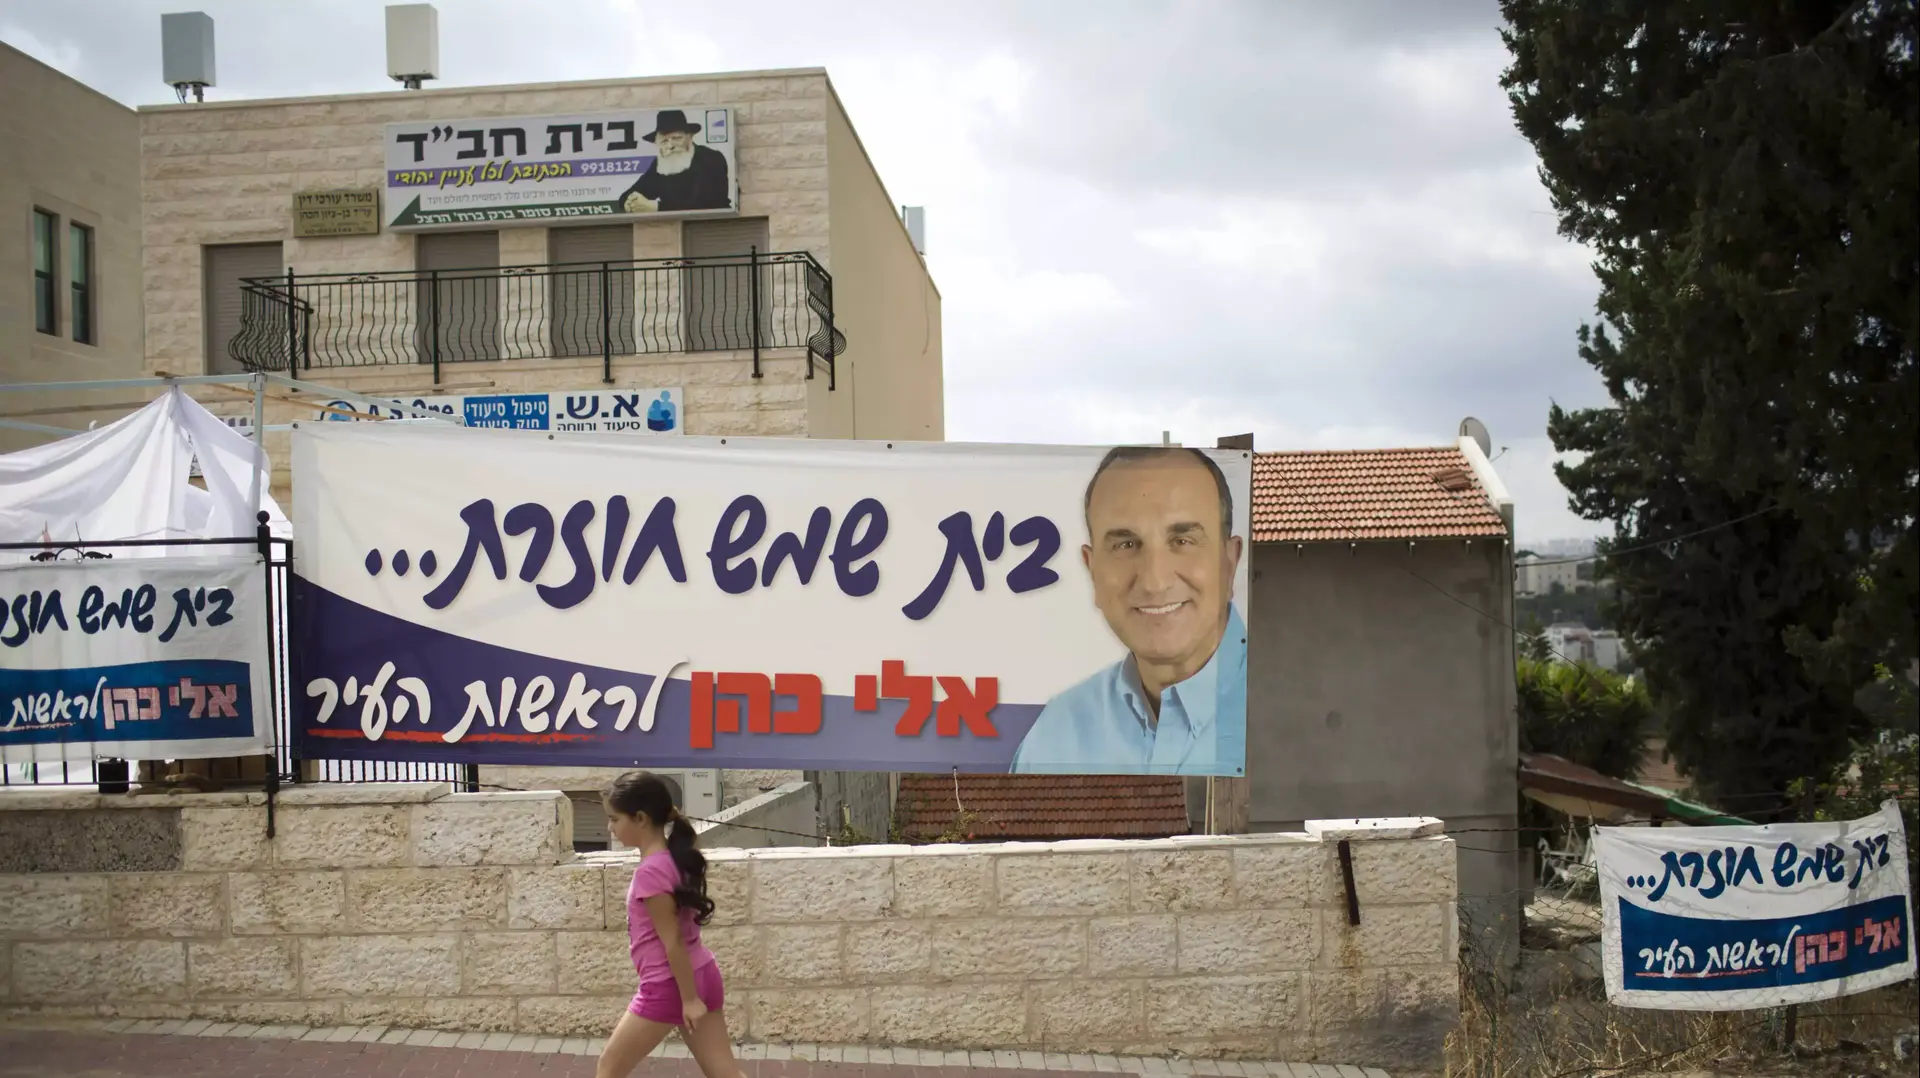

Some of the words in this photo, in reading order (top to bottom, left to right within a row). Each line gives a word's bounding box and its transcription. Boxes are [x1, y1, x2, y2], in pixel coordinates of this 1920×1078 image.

[544, 120, 638, 154] בית
[394, 170, 435, 185] יהודי
[439, 164, 476, 191] עניין
[480, 158, 511, 180] לכל
[507, 161, 573, 184] הכתובת
[580, 160, 640, 174] 9918127
[298, 195, 313, 208] דין
[315, 193, 342, 204] עורכי
[344, 192, 372, 203] משרד
[487, 210, 516, 221] ברק
[517, 207, 552, 218] סומר
[554, 204, 613, 216] באדיבות
[414, 212, 452, 224] הרצל
[465, 401, 506, 418] סיעודי
[511, 398, 547, 416] טיפול
[557, 421, 597, 432] ורווחה
[603, 420, 641, 432] סיעוד
[706, 494, 889, 598] שמש
[902, 510, 1061, 620] בית
[76, 583, 157, 635] שמש
[158, 586, 235, 643] בית
[7, 675, 108, 732] לראשות
[102, 686, 161, 731] כהן
[168, 676, 240, 719] אלי
[306, 660, 432, 742] העיר
[441, 661, 689, 744] לראשות
[689, 671, 823, 749] כהן
[853, 659, 999, 737] אלי
[1772, 842, 1844, 887] שמש
[1848, 833, 1891, 890] בית
[1700, 925, 1801, 978] לראשות
[1794, 929, 1848, 975] כהן
[1854, 915, 1902, 955] אלי
[1637, 937, 1696, 979] העיר
